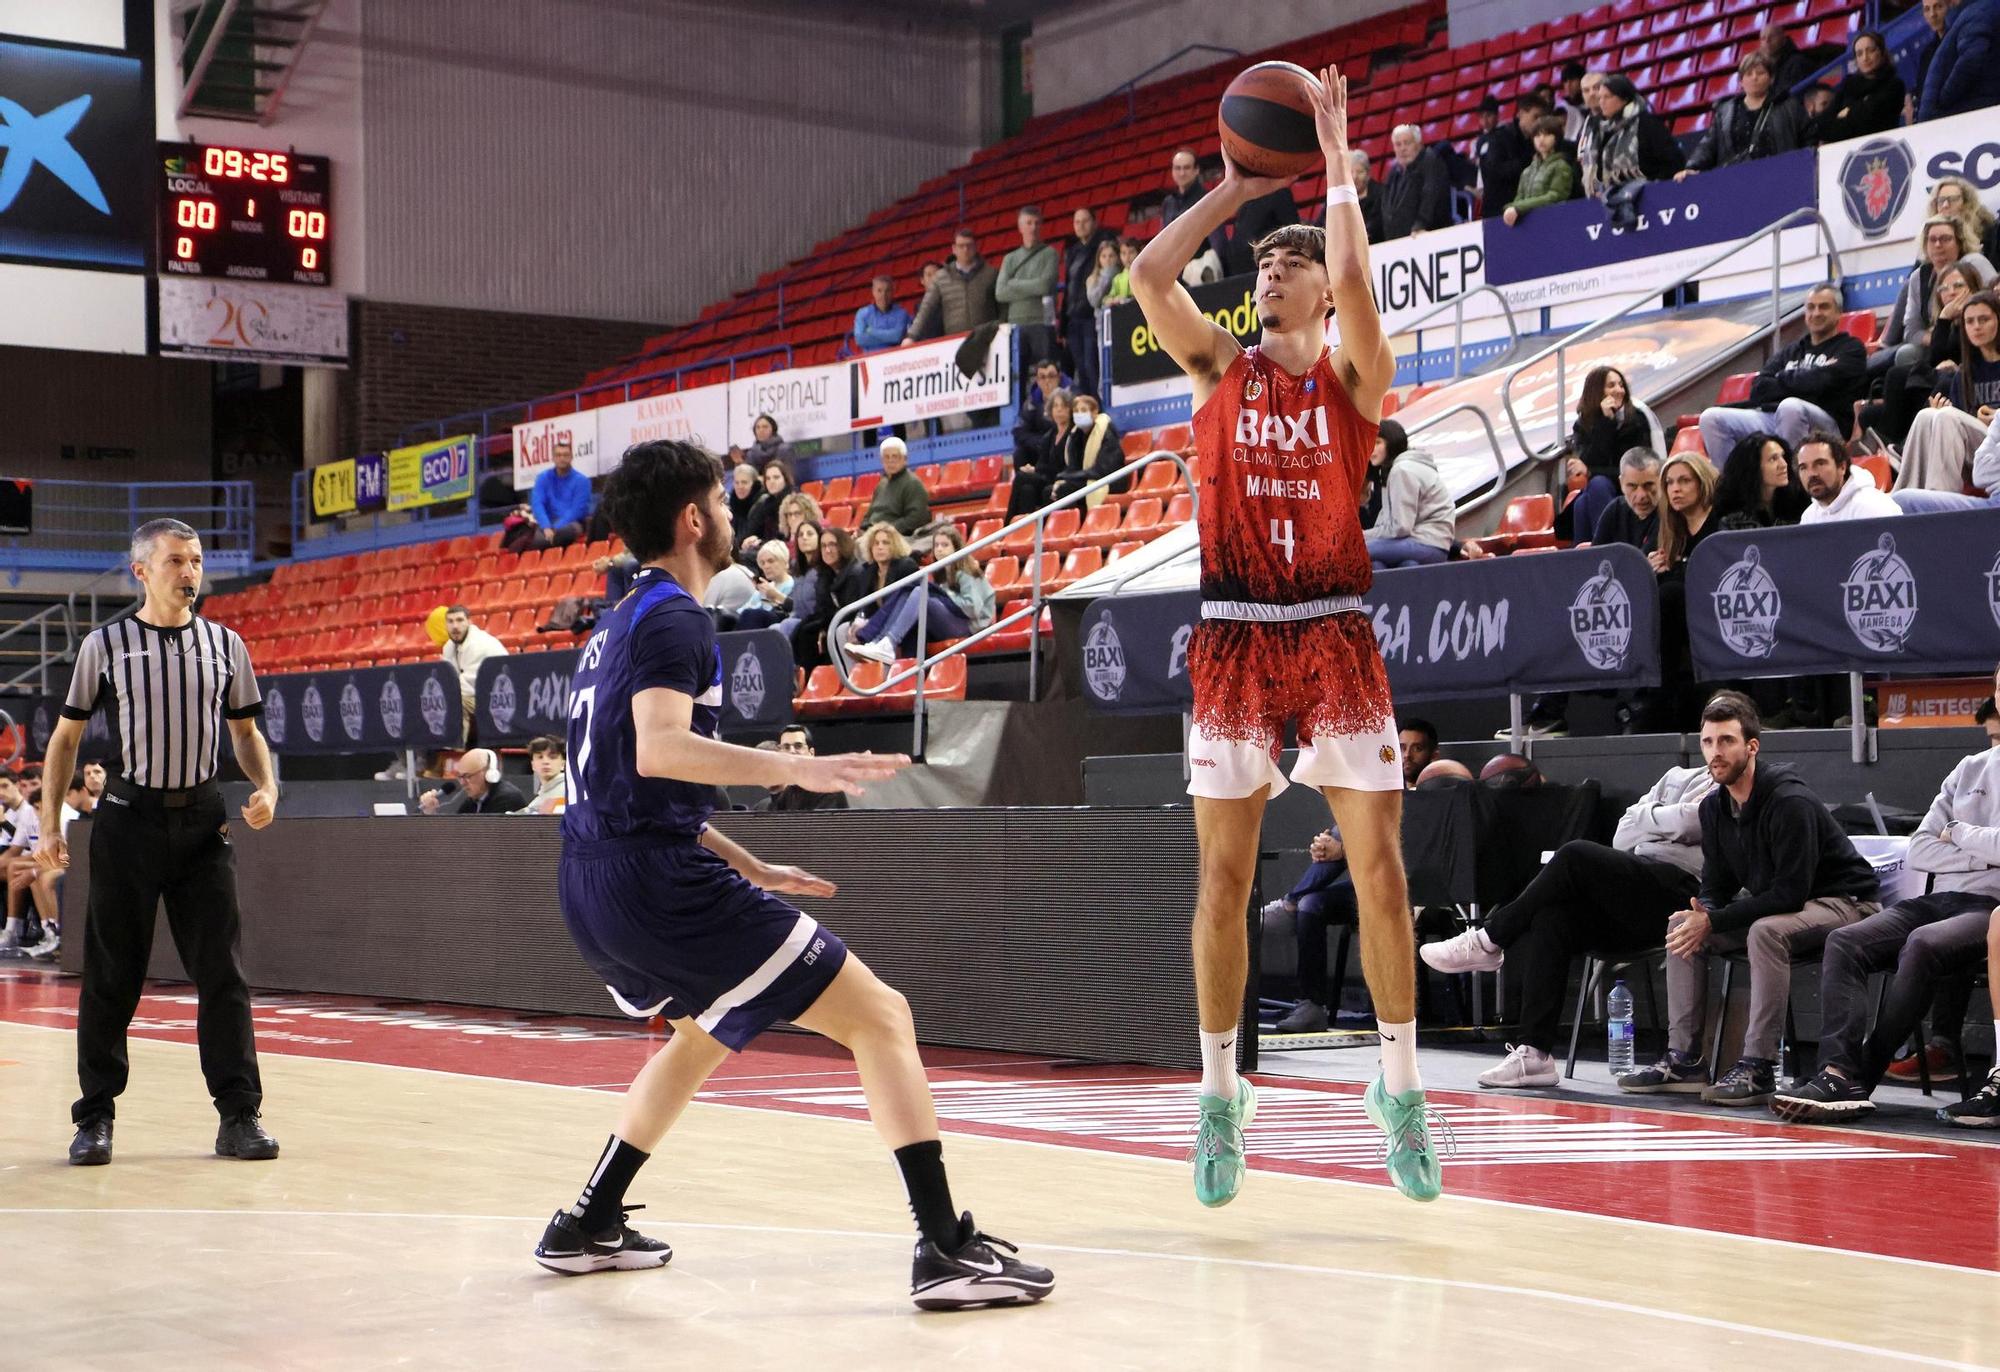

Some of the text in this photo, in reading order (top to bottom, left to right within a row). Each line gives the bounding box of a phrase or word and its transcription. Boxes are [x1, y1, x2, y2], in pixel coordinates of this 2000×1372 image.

[205, 148, 288, 182] 09:25
[168, 178, 213, 194] LOCAL
[178, 200, 216, 229] 00
[288, 210, 325, 239] 00
[177, 237, 193, 258] 0
[302, 247, 316, 269] 0
[168, 260, 200, 273] FALTES
[1372, 244, 1484, 314] IGNEP
[1549, 276, 1600, 297] Premium
[1235, 403, 1330, 451] BAXI
[1246, 474, 1321, 500] MANRESA
[1270, 518, 1295, 564] 4
[1716, 591, 1778, 620] BAXI
[1848, 580, 1914, 613] BAXI
[1574, 603, 1631, 633] BAXI
[1858, 615, 1904, 629] MANRESA
[1086, 647, 1125, 668] BAXI
[733, 674, 763, 693] BAXI
